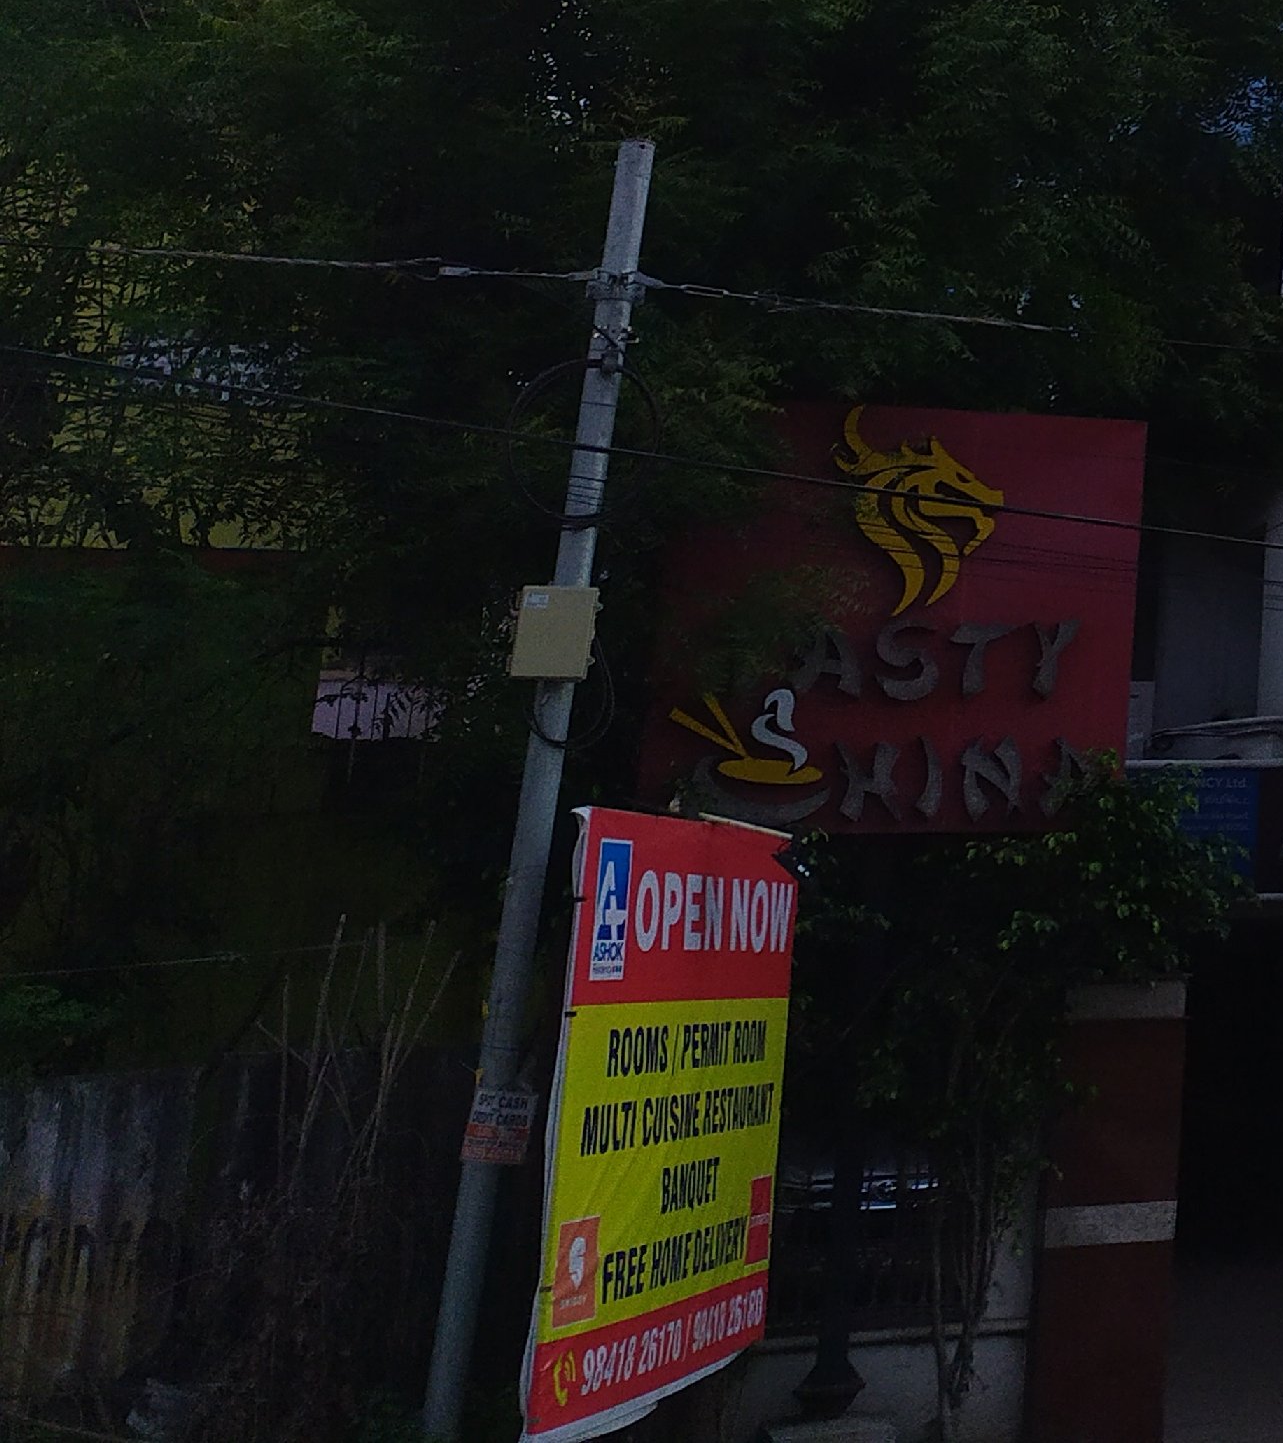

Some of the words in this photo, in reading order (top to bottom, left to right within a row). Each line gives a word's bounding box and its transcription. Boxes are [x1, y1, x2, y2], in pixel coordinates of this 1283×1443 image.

[795, 619, 1081, 702] ASTY
[635, 869, 724, 953] OPEN
[729, 877, 794, 954] NOW
[606, 1025, 669, 1077] ROOMS
[681, 1021, 731, 1069] PERMIT
[733, 1020, 767, 1064] ROOM
[580, 1100, 637, 1157] MULTI
[642, 1092, 700, 1146] CUISINE
[703, 1082, 775, 1135] RESTAURANT
[660, 1157, 720, 1213] BANQUET
[602, 1244, 648, 1305] FREE
[650, 1231, 693, 1290] HOME
[693, 1215, 749, 1275] DELIVERY
[580, 1335, 638, 1396] 98418
[636, 1318, 683, 1376] 26170
